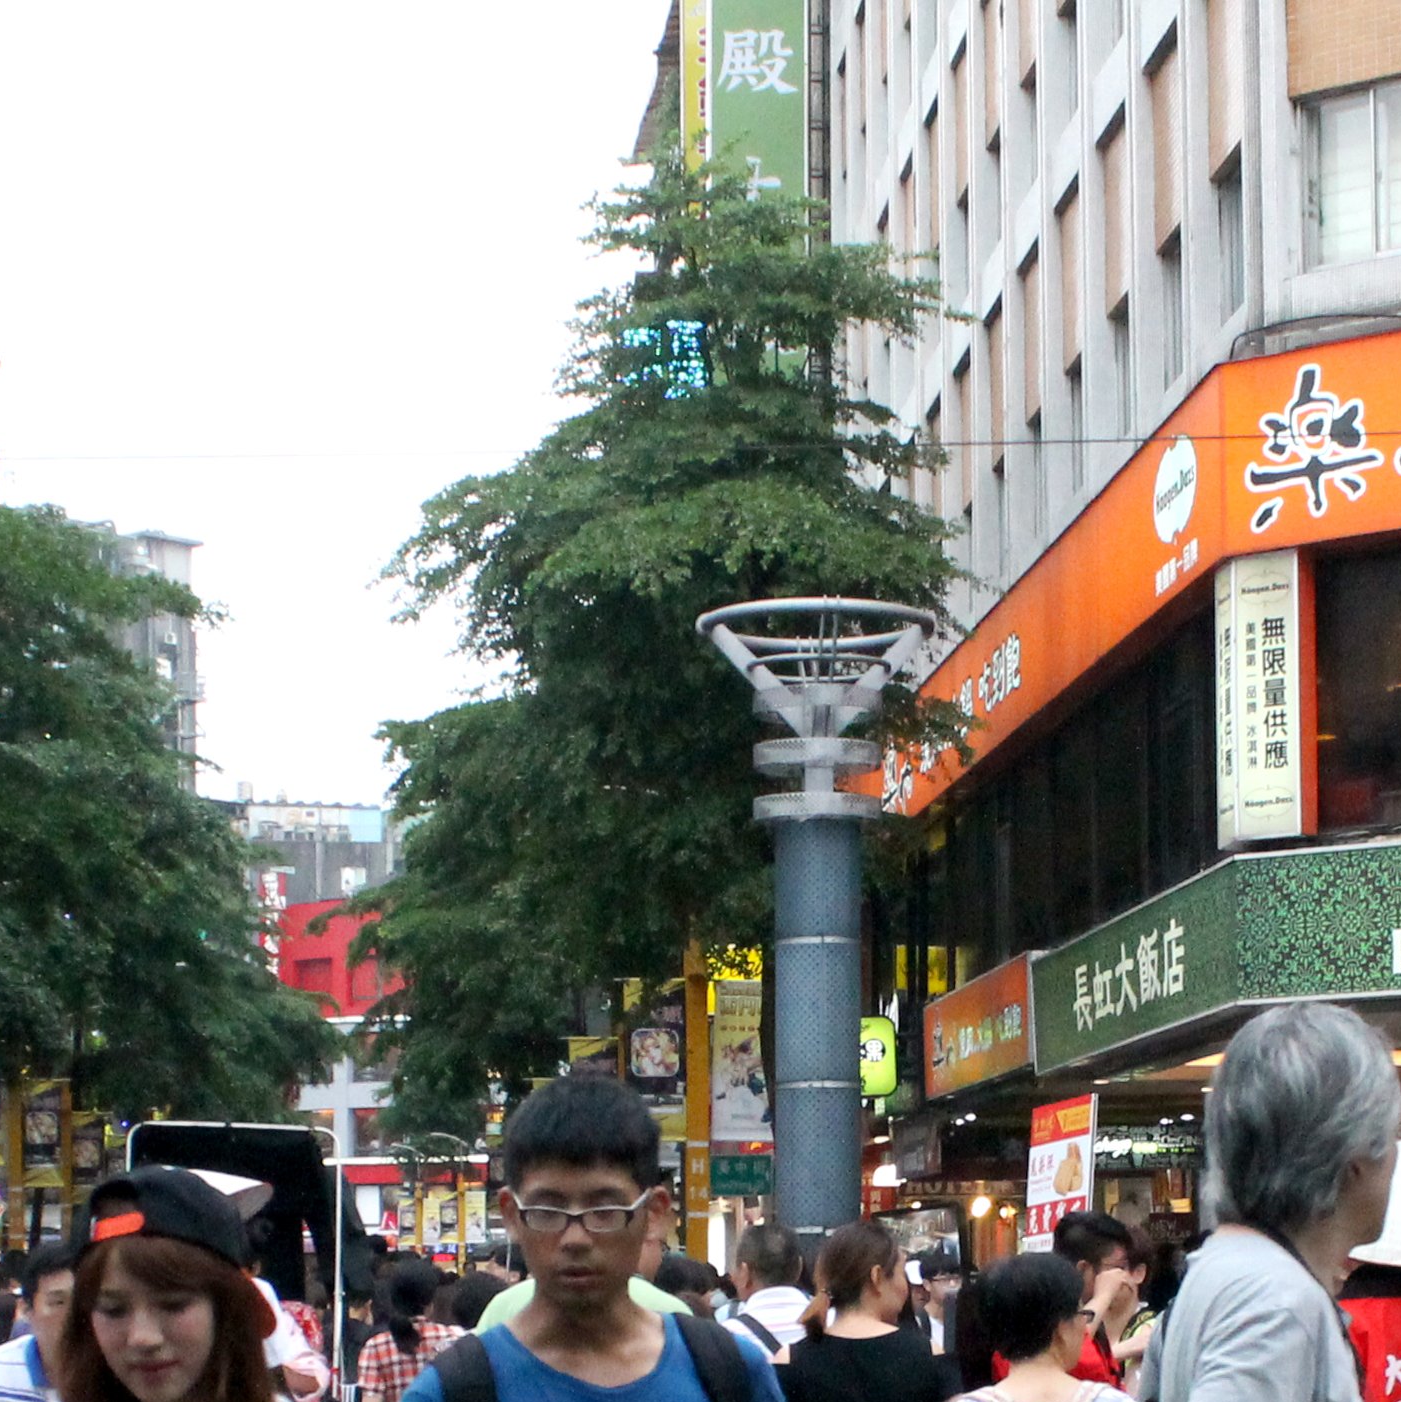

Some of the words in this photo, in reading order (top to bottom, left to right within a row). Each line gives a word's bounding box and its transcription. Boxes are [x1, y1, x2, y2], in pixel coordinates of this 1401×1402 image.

[717, 29, 799, 95] 殿
[1261, 617, 1289, 769] 無限量供應
[1072, 918, 1186, 1033] 長虹大飯店
